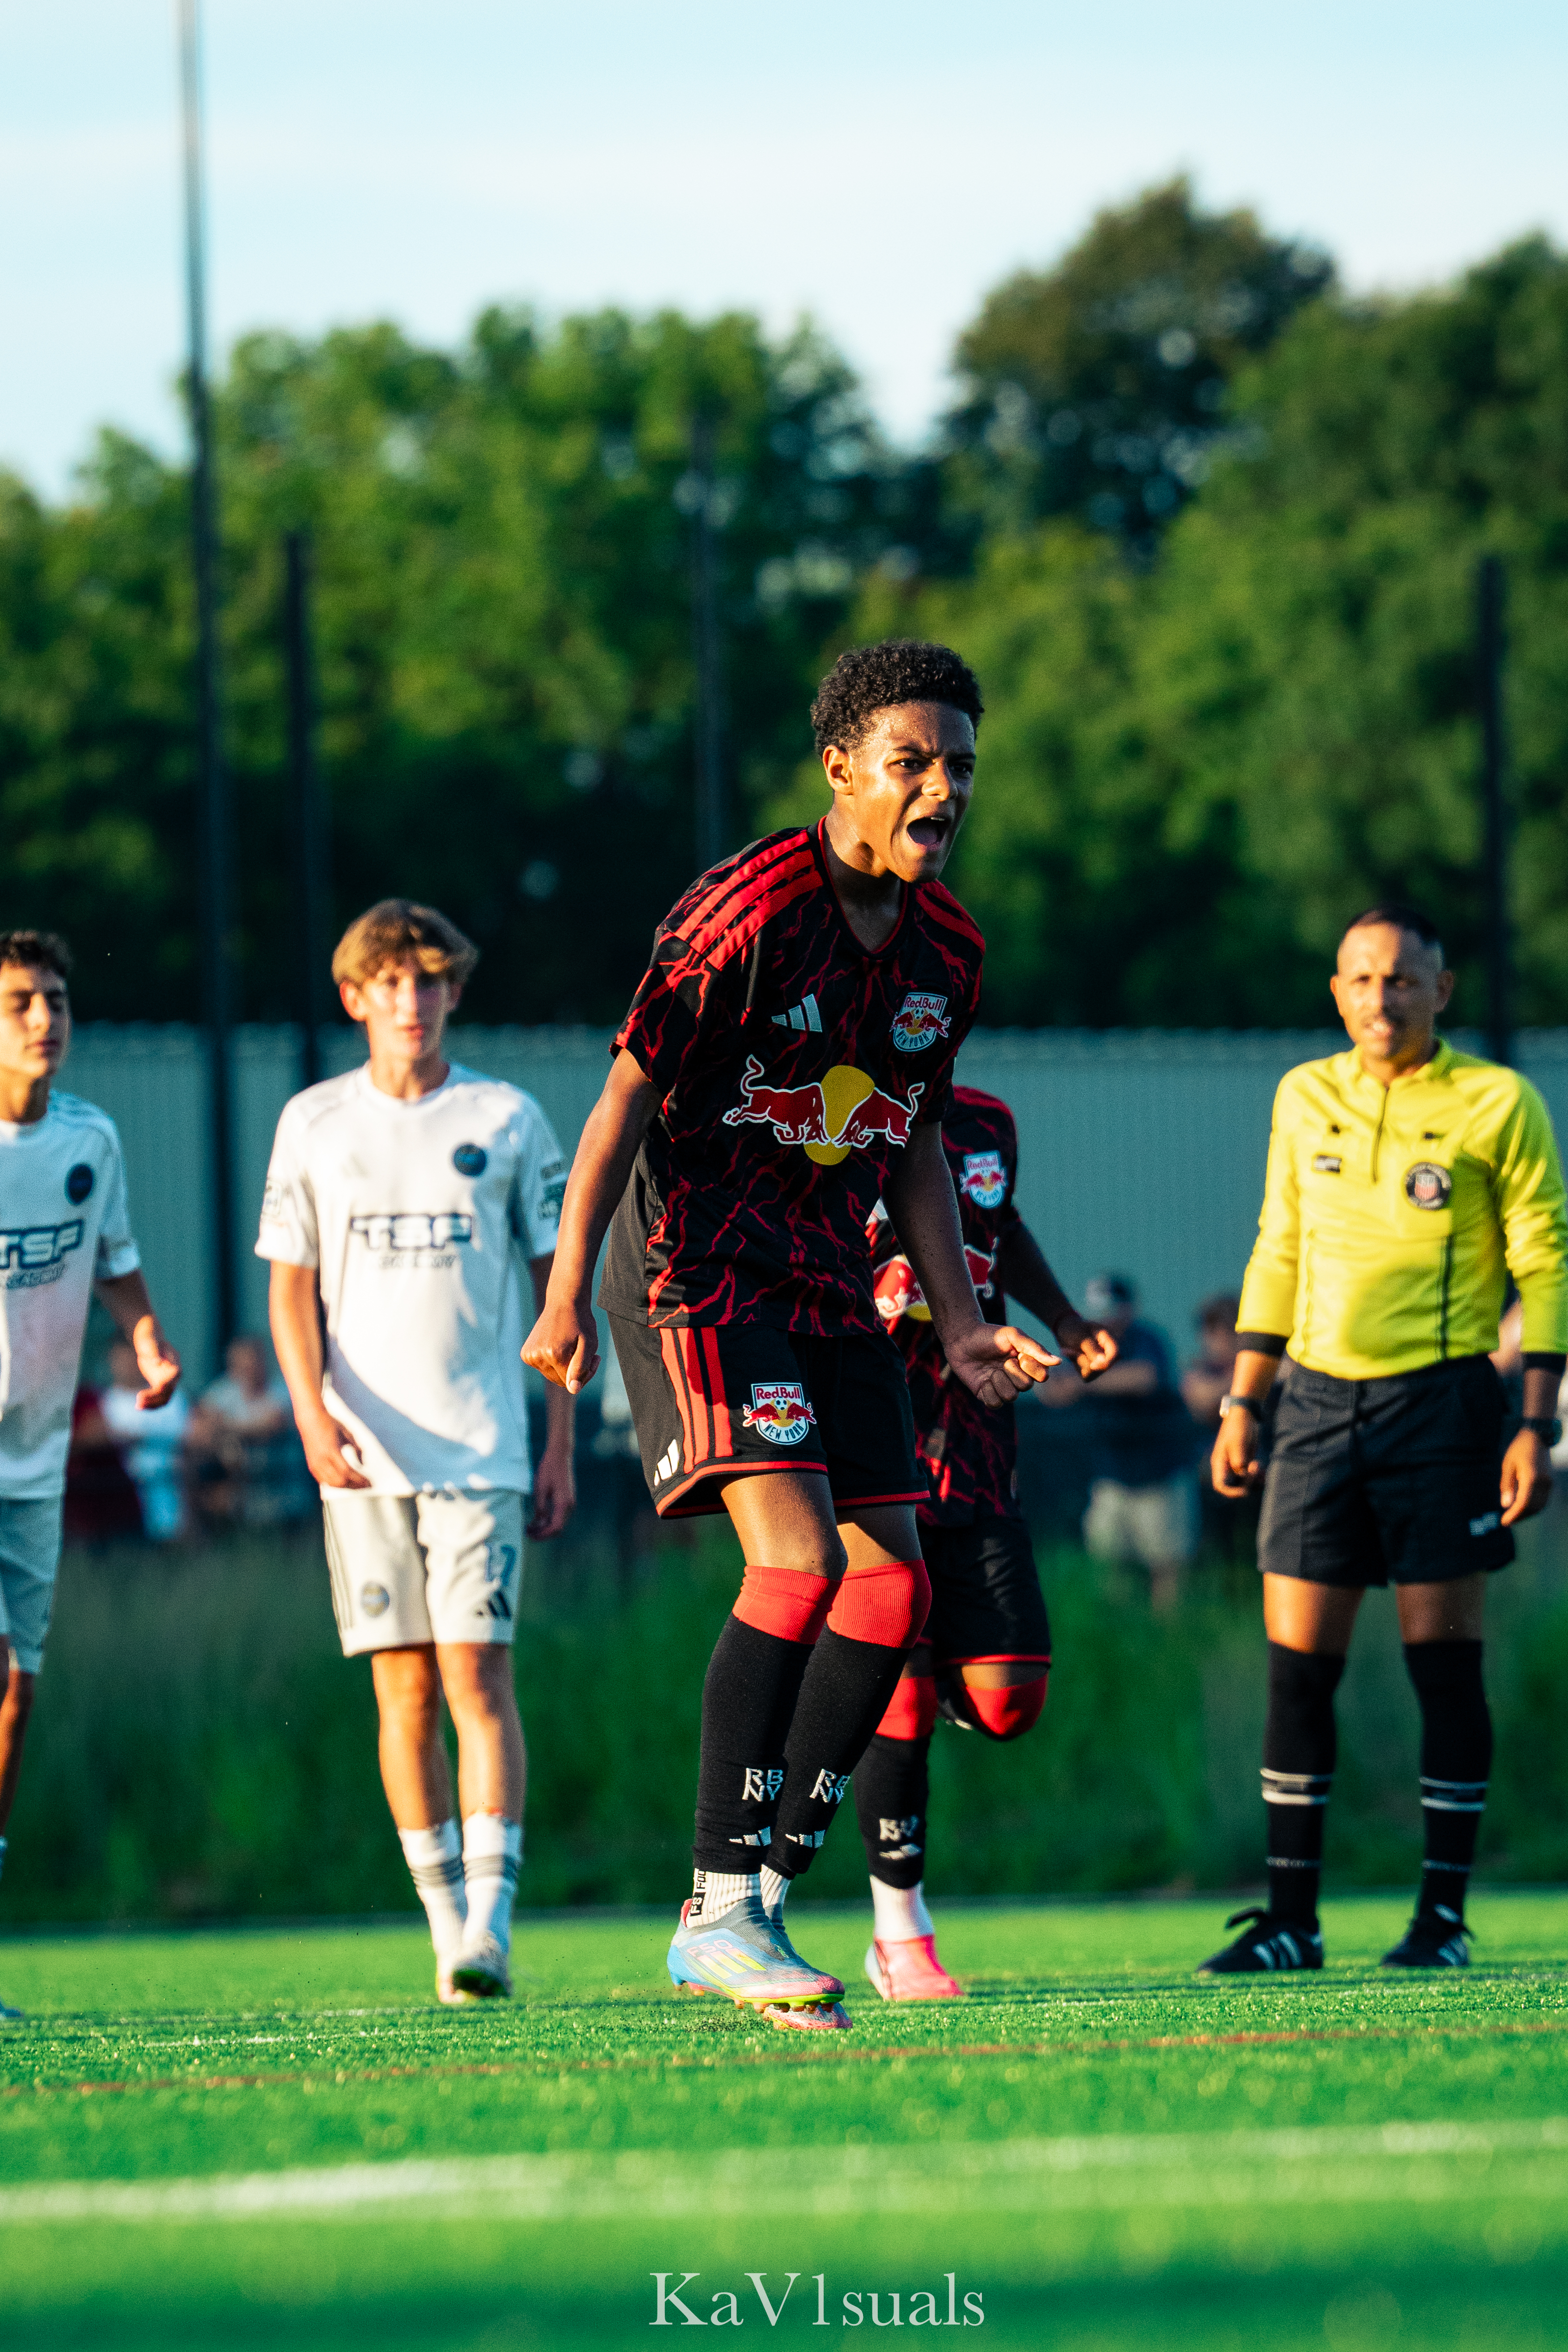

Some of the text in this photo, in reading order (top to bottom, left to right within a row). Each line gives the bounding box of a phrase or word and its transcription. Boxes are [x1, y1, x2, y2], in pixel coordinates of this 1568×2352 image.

[895, 1031, 929, 1047] NEW YORK
[763, 1423, 804, 1440] NEW YORK
